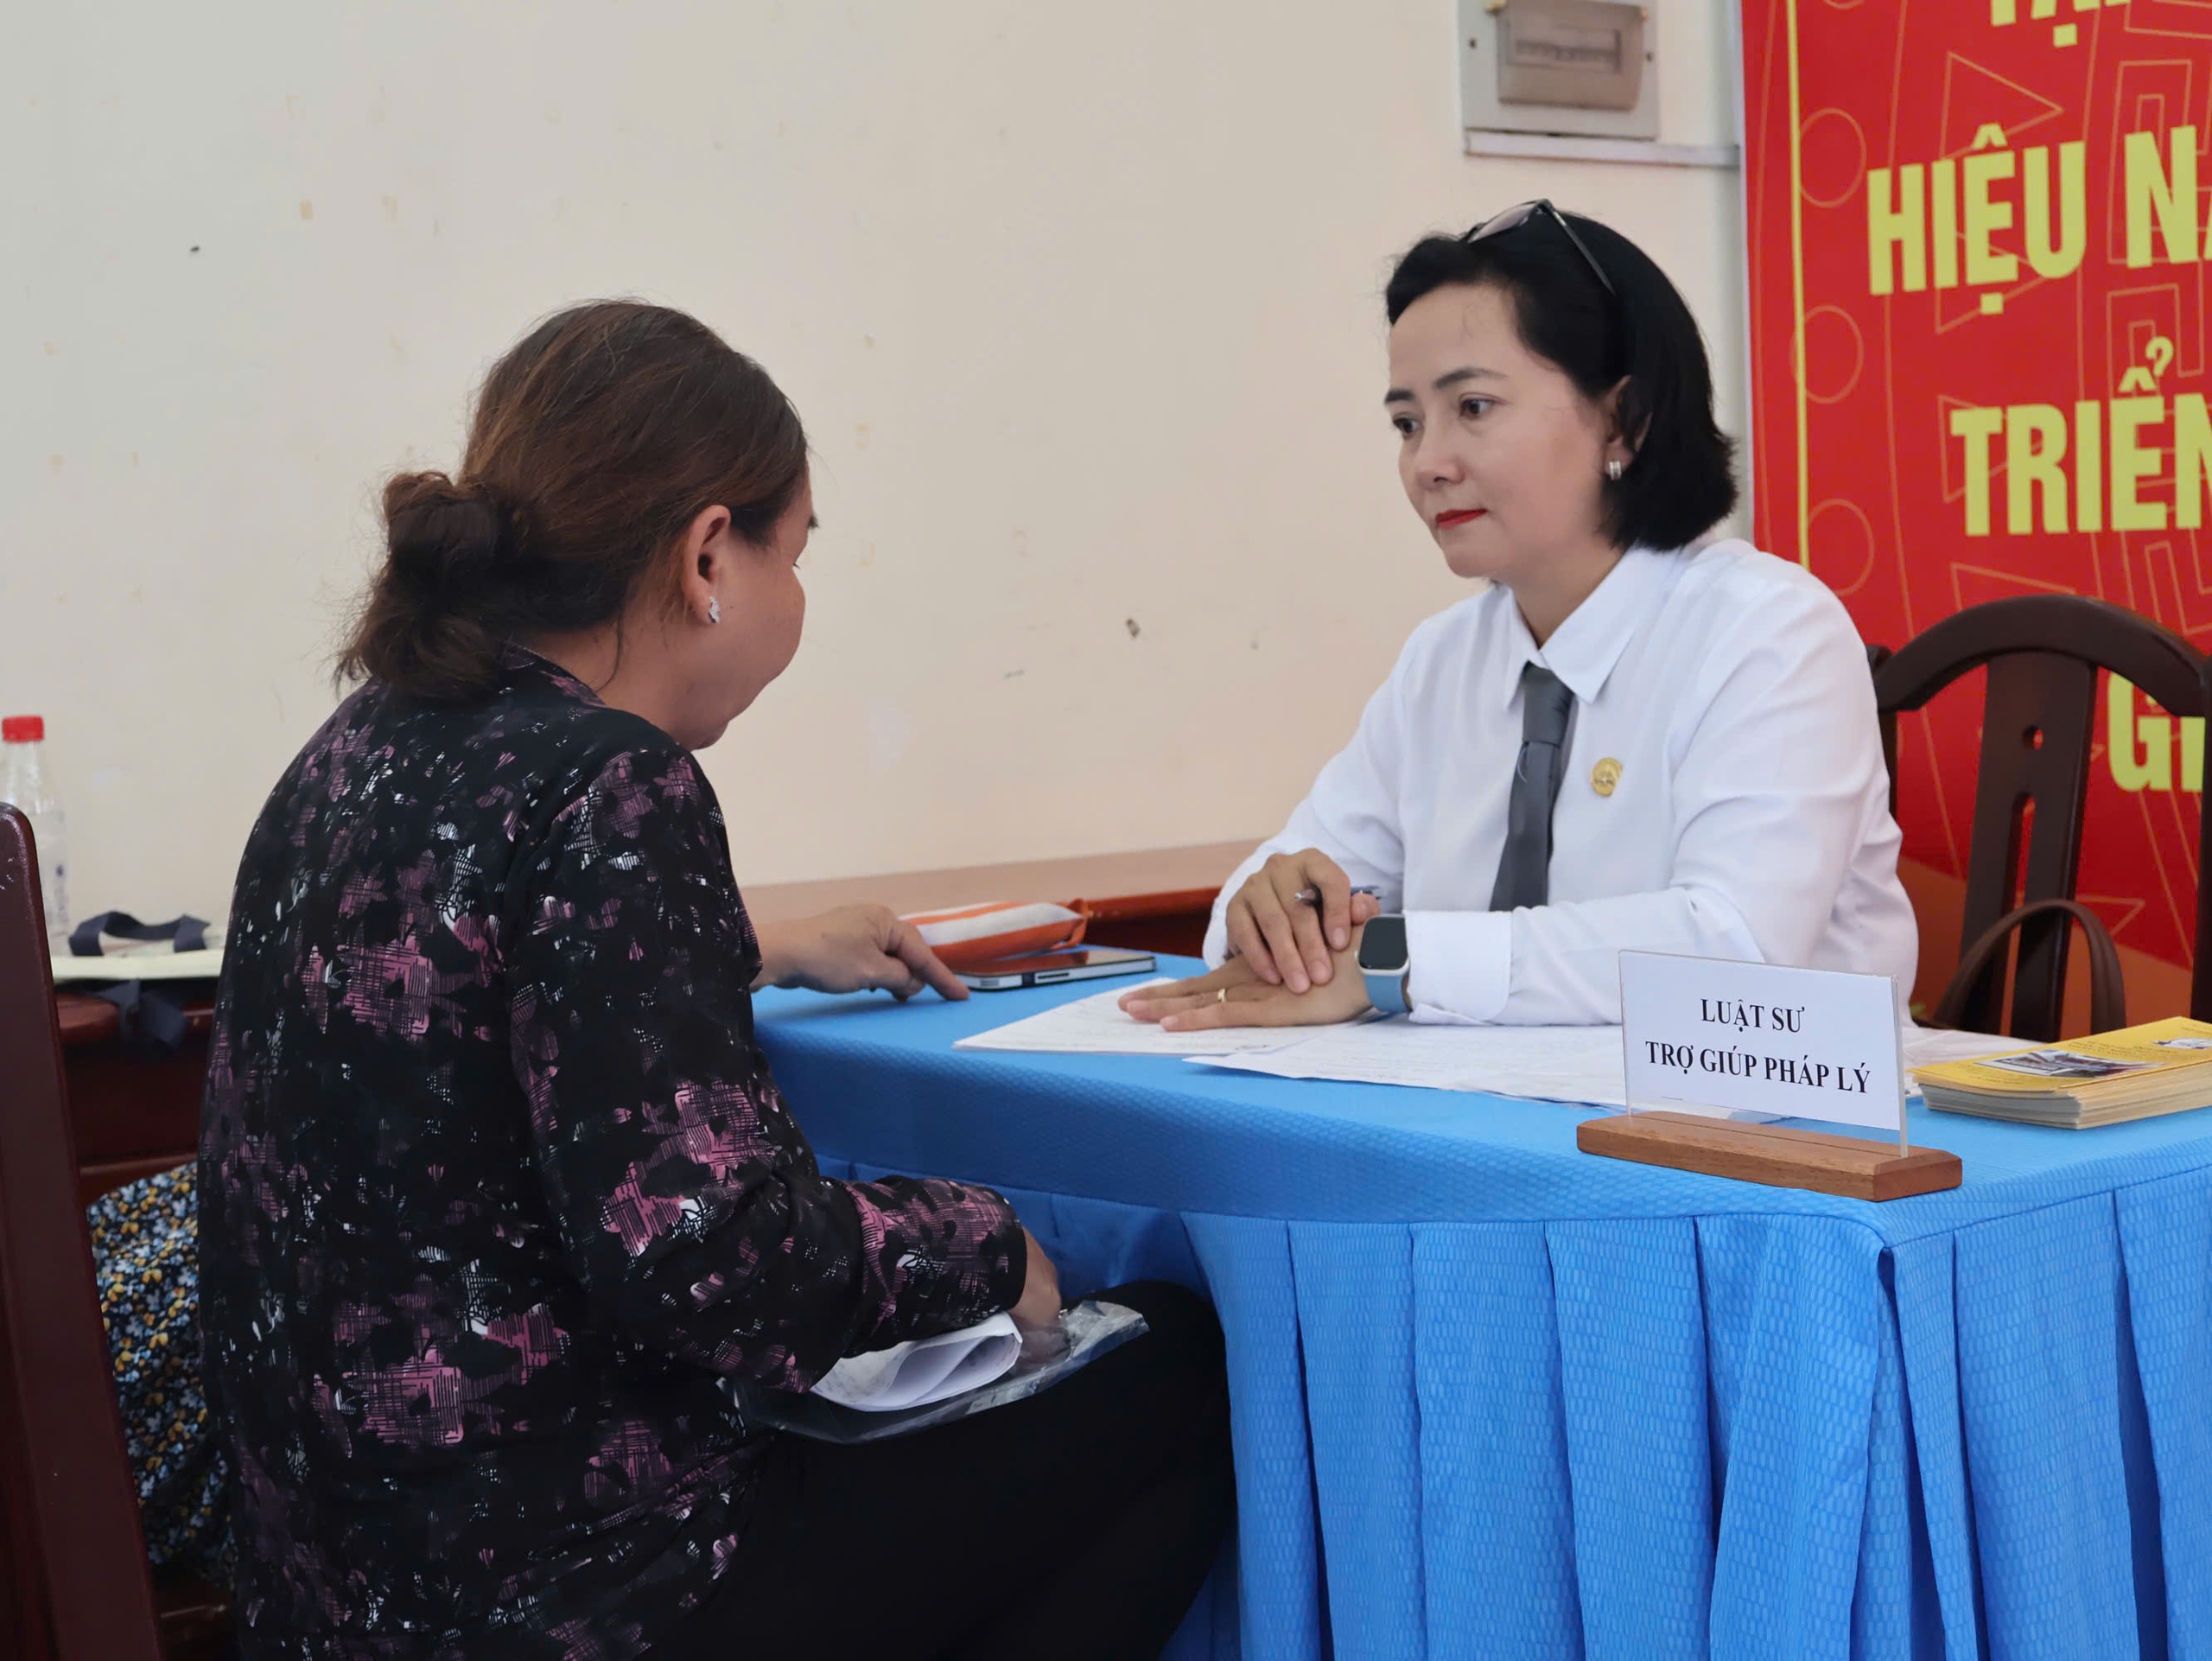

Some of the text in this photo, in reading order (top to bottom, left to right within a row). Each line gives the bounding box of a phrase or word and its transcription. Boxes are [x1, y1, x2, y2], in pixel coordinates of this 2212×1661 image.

[1867, 123, 2212, 315] HIỆU N
[1700, 998, 1805, 1033] LUẬT SƯ
[1645, 1041, 1872, 1094] TRỢ GIÚP PHÁP LÝ
